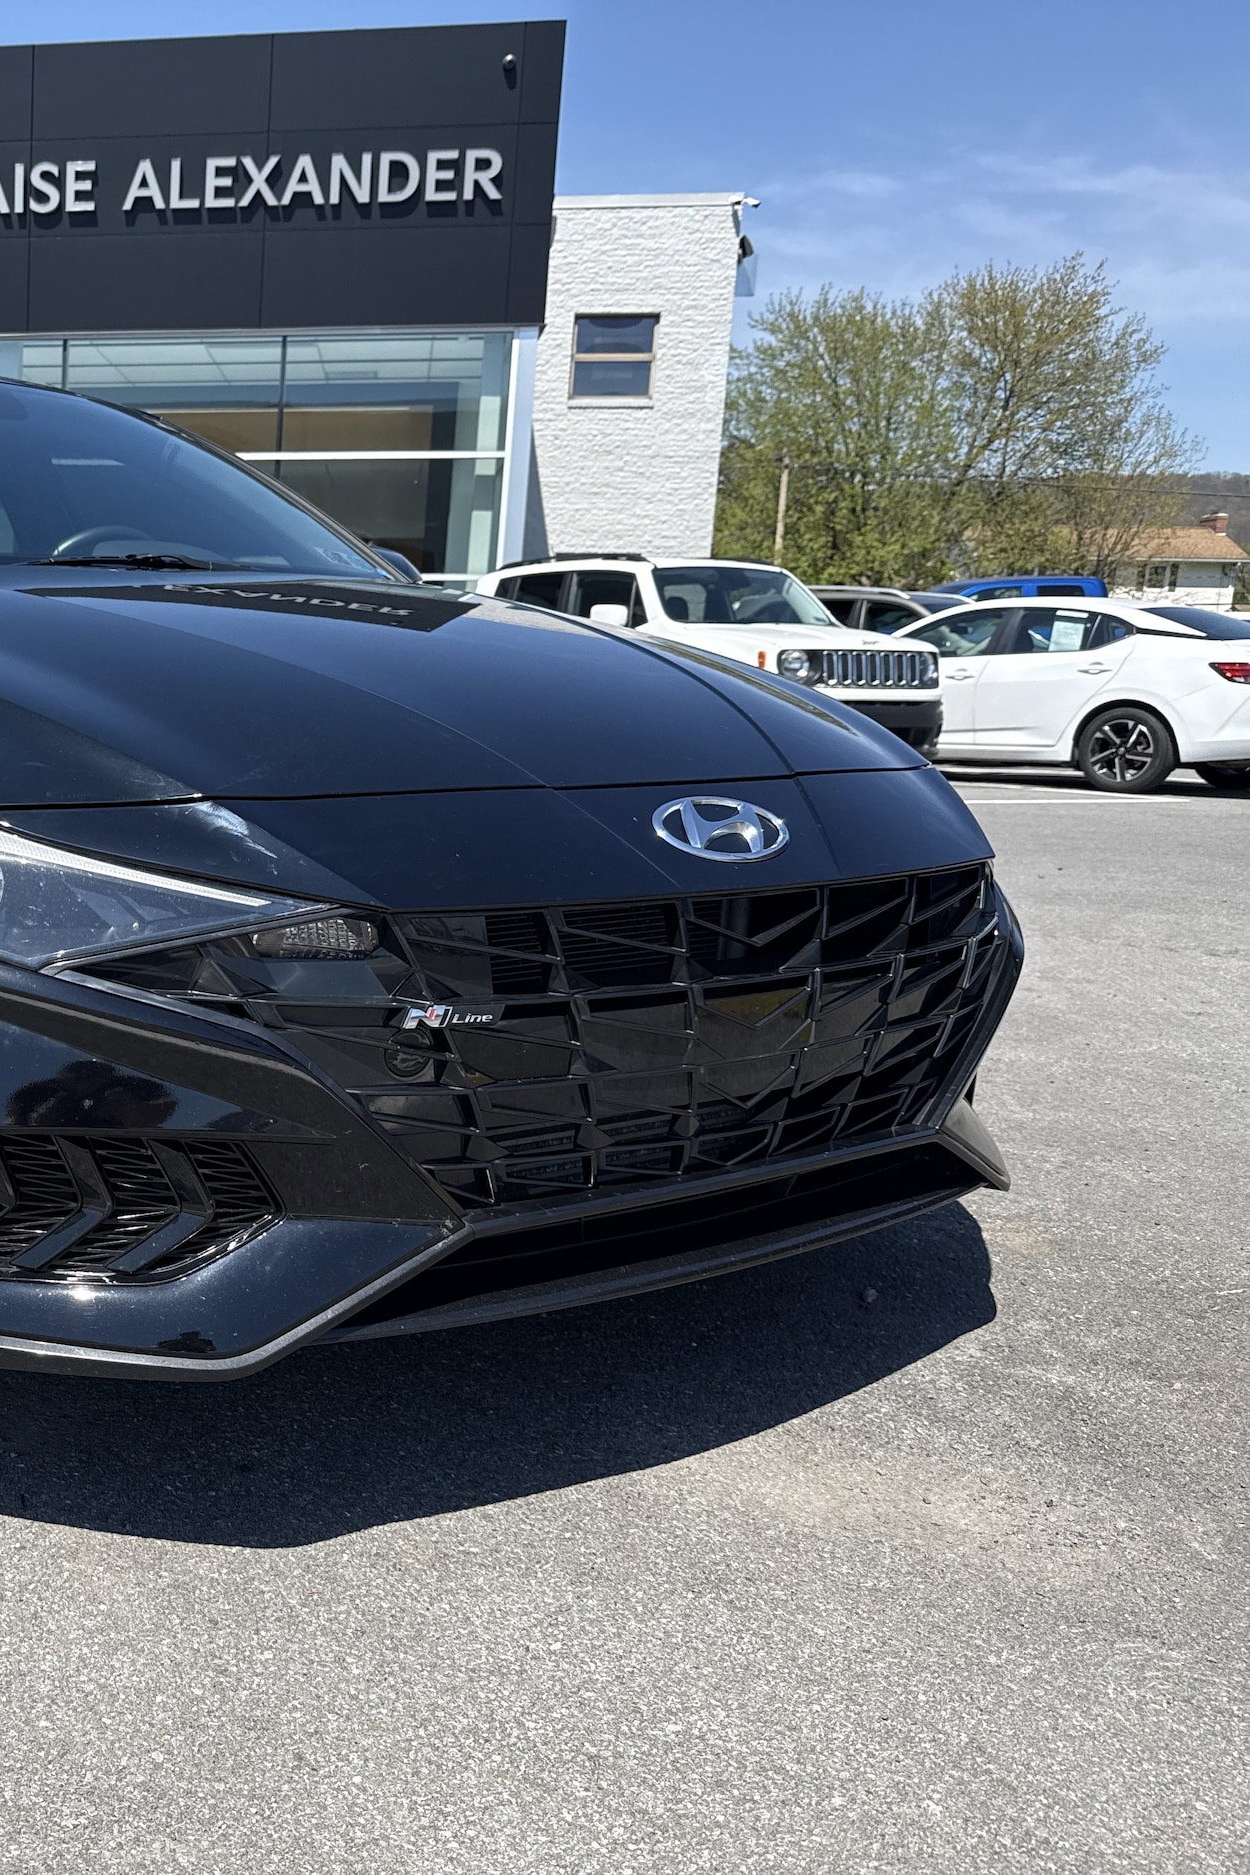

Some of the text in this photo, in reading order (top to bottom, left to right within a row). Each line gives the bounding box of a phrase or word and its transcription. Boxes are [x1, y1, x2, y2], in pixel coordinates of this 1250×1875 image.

[122, 148, 504, 212] ALEXANDER
[403, 1004, 493, 1029] N Line
